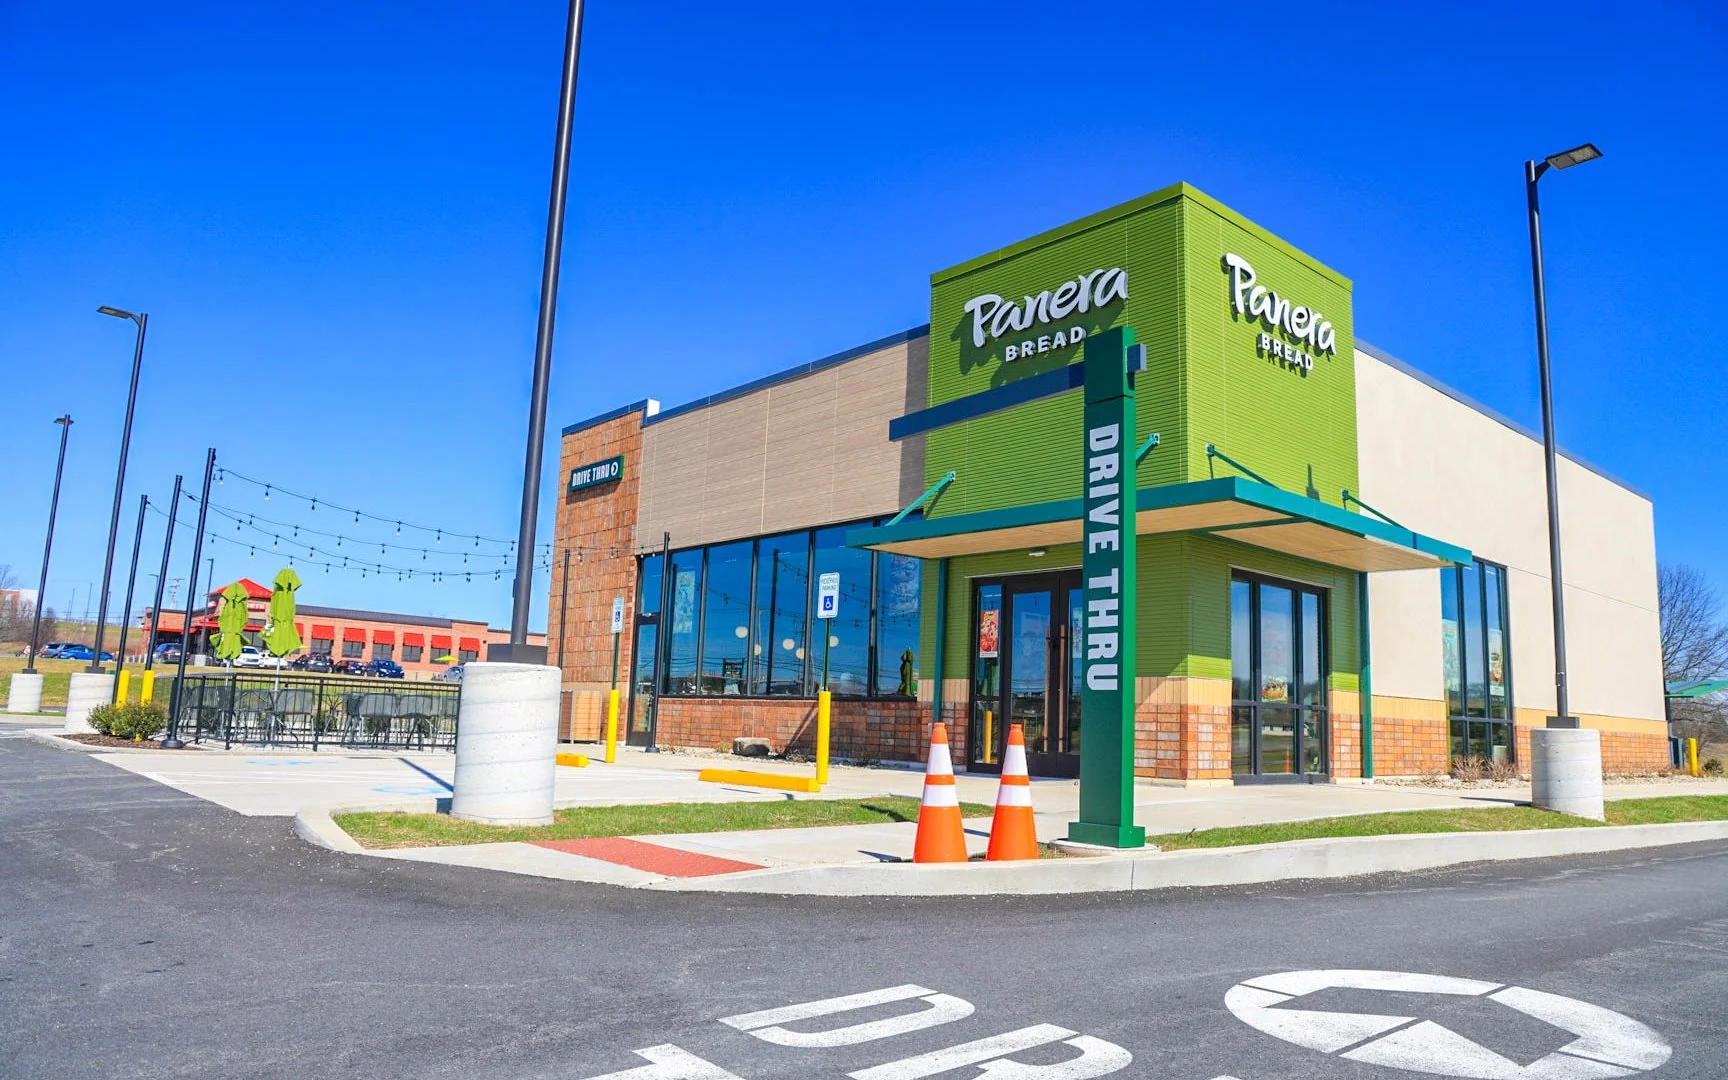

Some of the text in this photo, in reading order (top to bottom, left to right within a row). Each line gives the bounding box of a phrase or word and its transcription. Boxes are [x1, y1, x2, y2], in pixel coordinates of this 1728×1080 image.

[964, 267, 1129, 347] Panera
[1224, 252, 1337, 355] Panera
[1005, 326, 1086, 362] BREAD
[1260, 333, 1314, 371] BREAD
[572, 463, 610, 487] DRIVE THRU
[1086, 423, 1120, 691] DRIVE THRU
